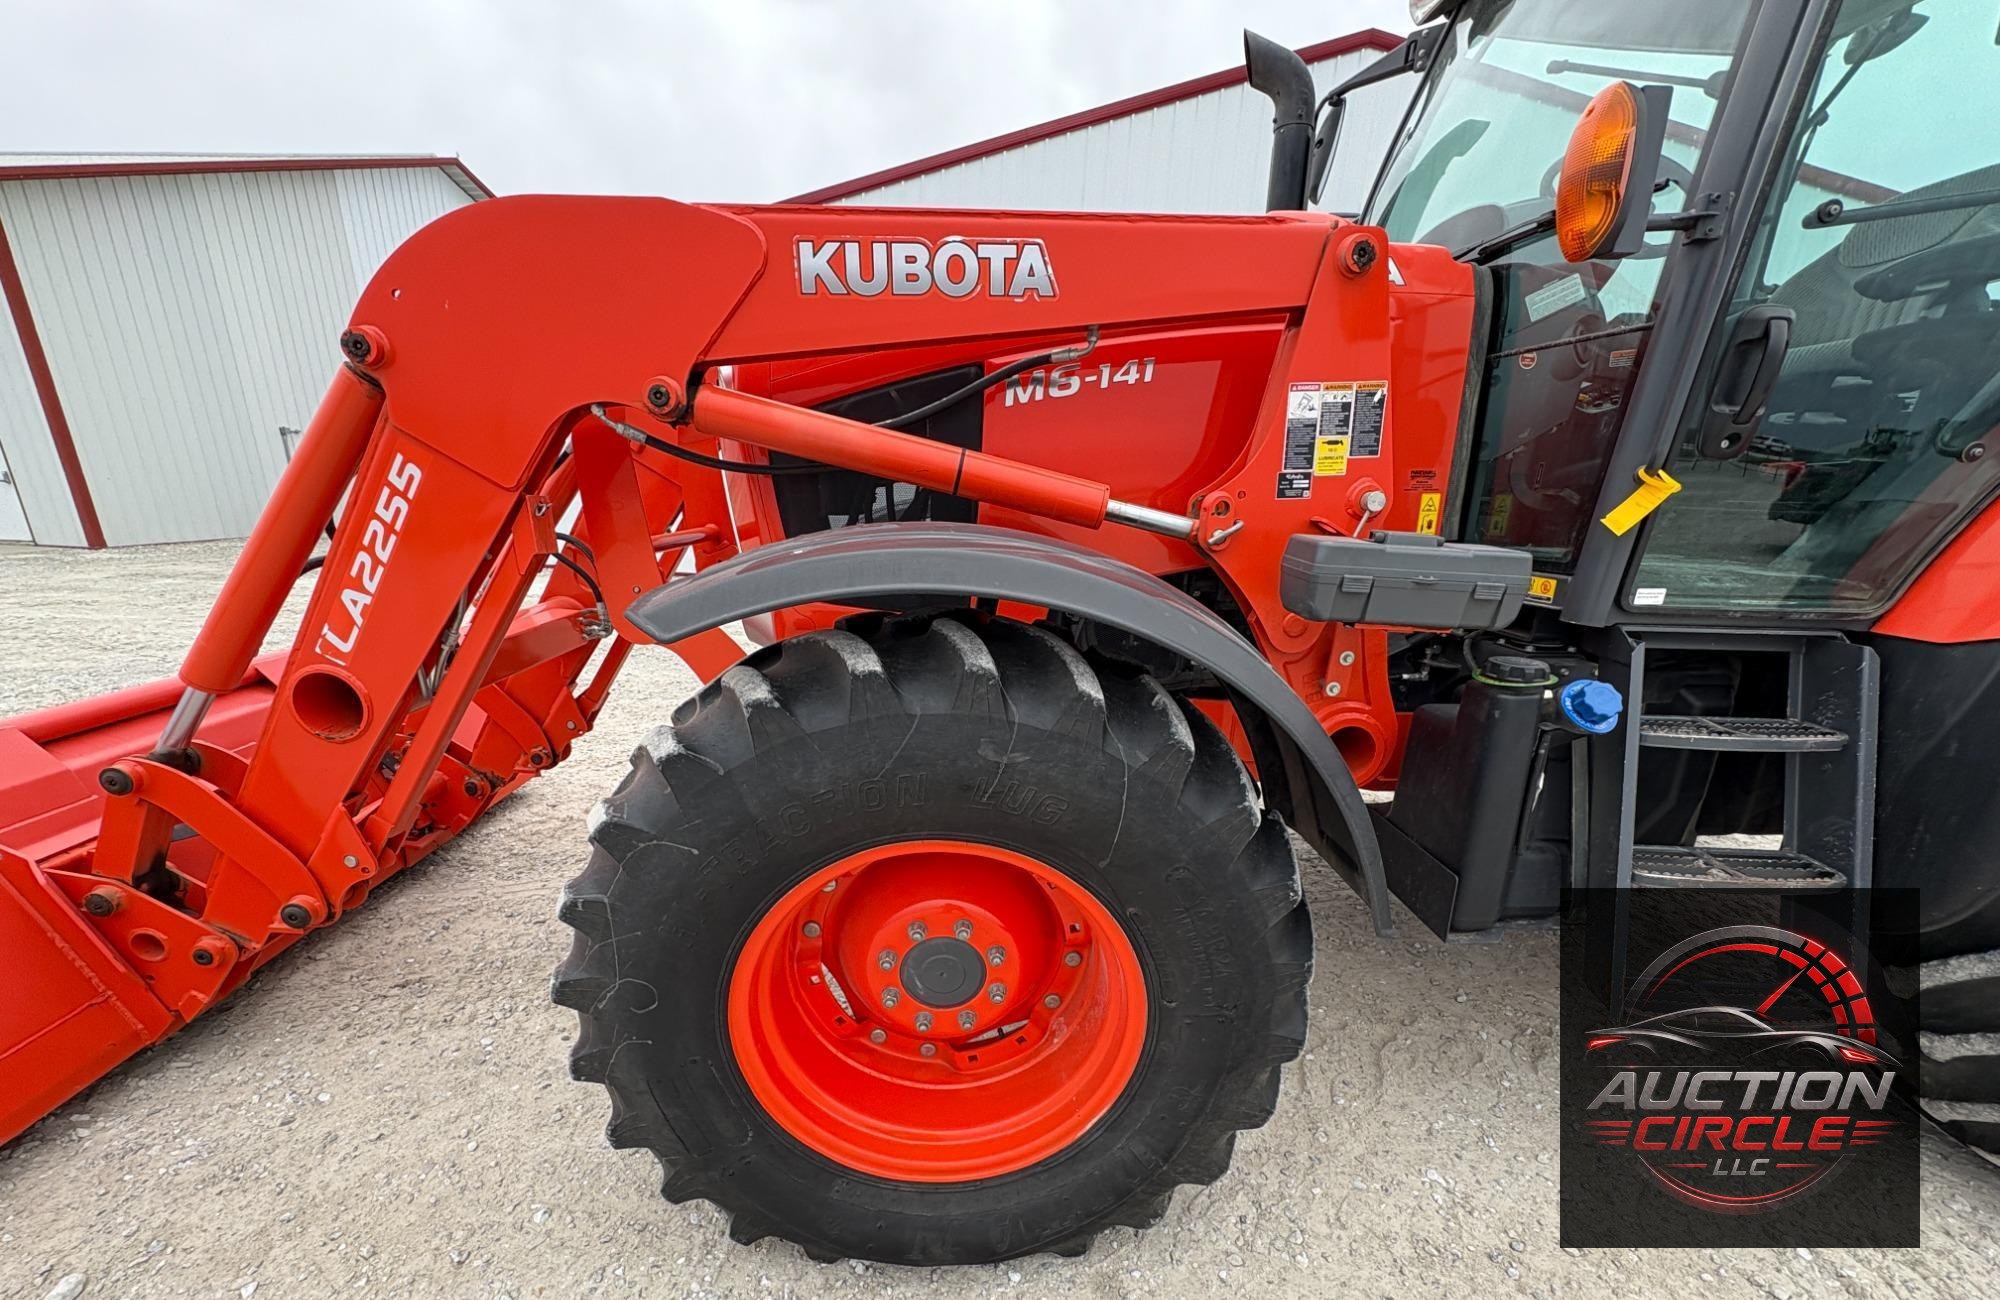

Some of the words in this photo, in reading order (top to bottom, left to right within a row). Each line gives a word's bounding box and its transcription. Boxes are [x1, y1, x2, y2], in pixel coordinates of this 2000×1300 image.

[797, 239, 1057, 298] KUBOTA
[1003, 357, 1157, 408] M6-141
[323, 452, 423, 656] LA2255
[968, 775, 1071, 826] LUG
